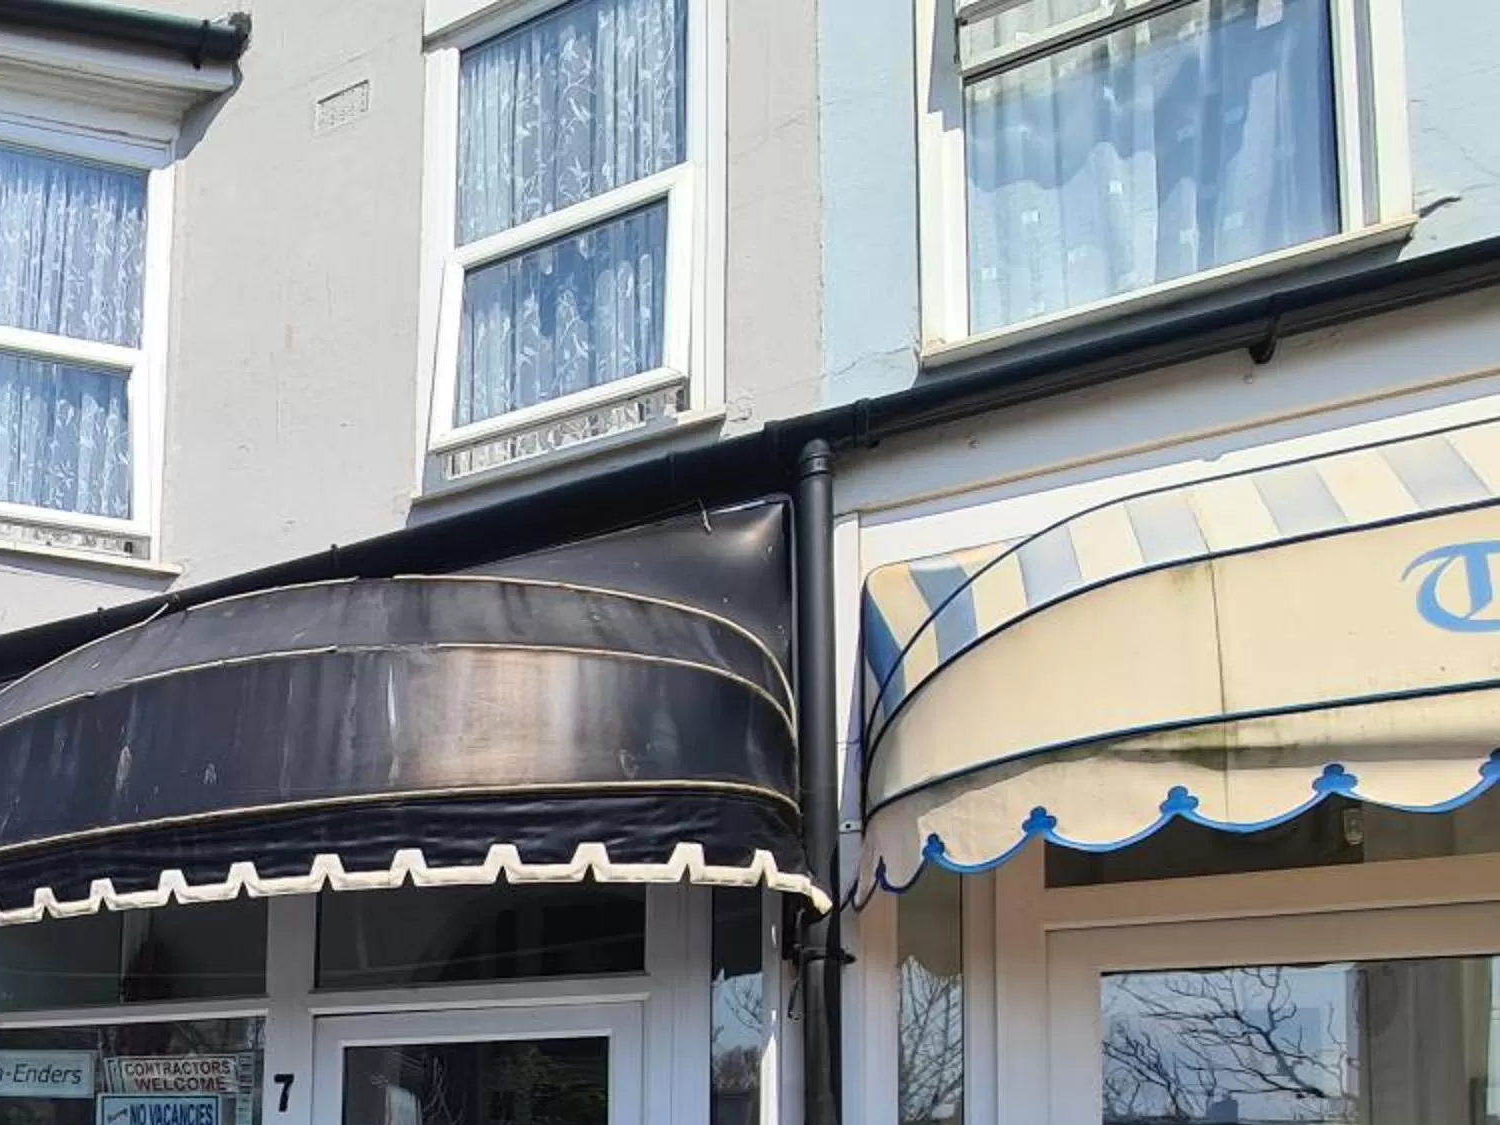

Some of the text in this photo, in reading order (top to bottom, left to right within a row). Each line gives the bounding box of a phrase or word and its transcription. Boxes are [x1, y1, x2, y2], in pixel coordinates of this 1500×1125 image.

[125, 1060, 231, 1076] CONTRACTORS
[134, 1076, 228, 1092] WELCOME
[274, 1073, 294, 1113] 7
